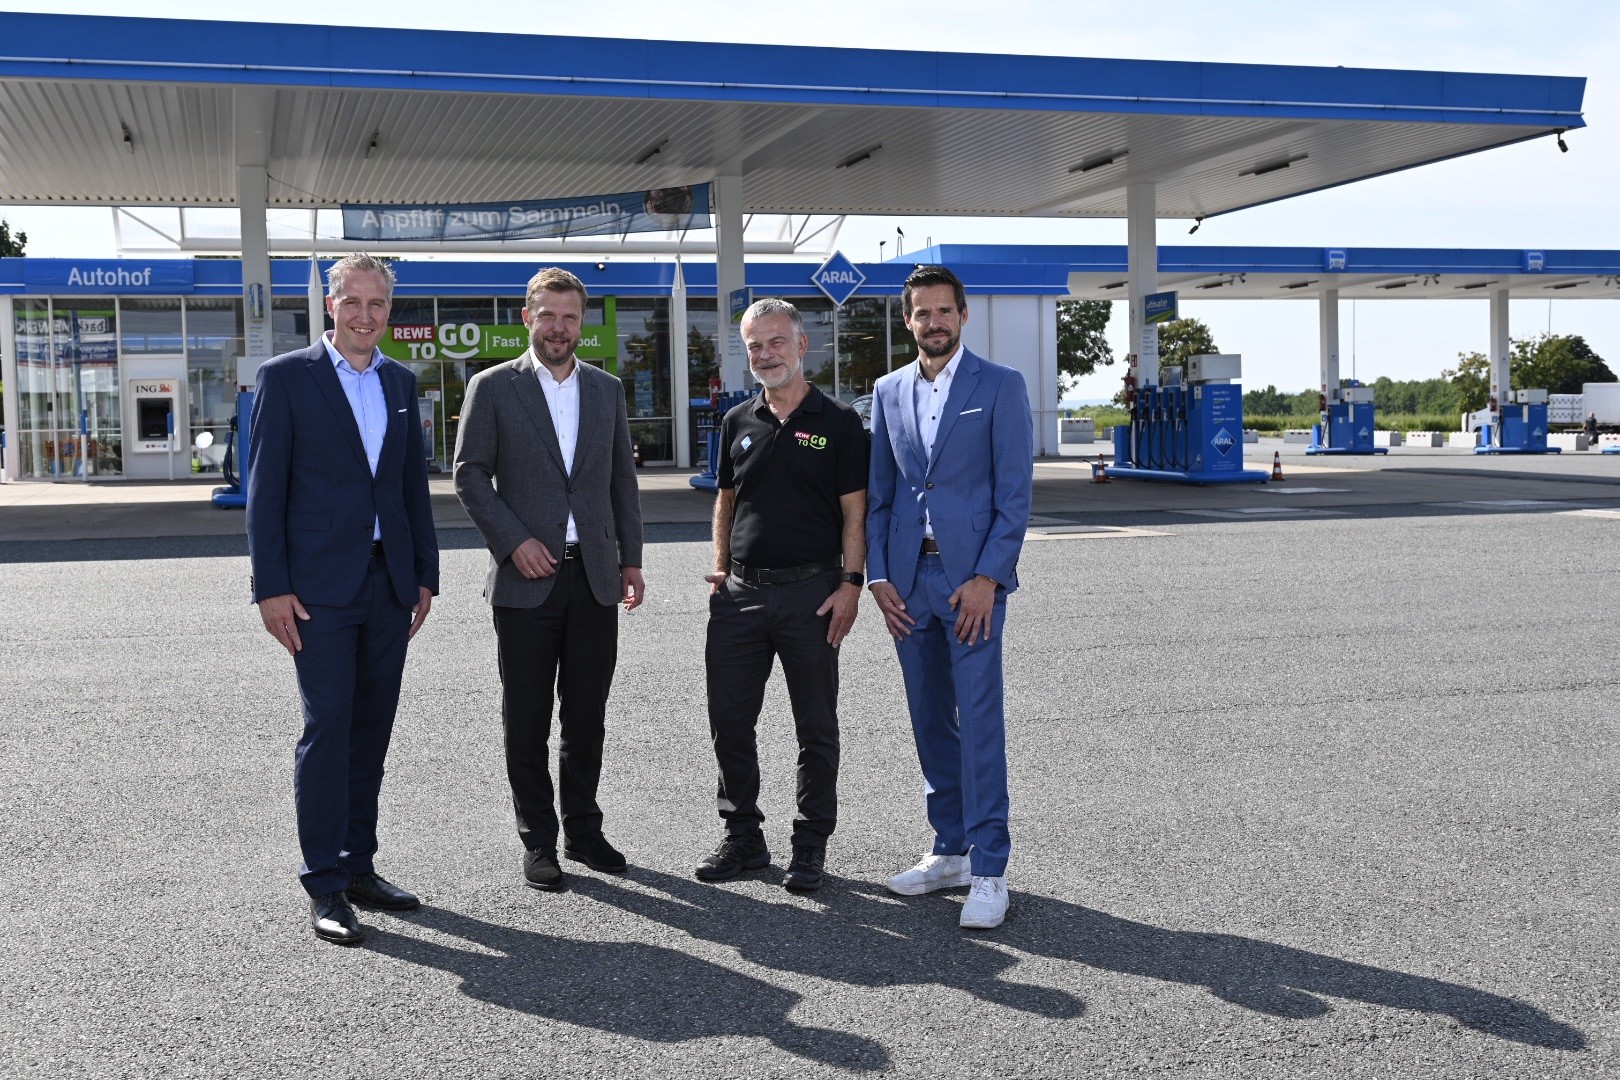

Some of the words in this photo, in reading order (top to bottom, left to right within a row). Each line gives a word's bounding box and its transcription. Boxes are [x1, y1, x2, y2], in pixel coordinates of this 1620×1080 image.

[361, 209, 443, 232] Anpfiff
[450, 210, 502, 228] zum
[508, 200, 626, 224] Sammeln.
[67, 266, 152, 286] Autohof
[820, 270, 858, 284] ARAL
[393, 326, 433, 340] REWE
[438, 322, 481, 347] GO
[492, 335, 524, 347] Fast.
[577, 335, 602, 347] ood.
[407, 342, 437, 360] TO
[136, 385, 157, 393] ING
[797, 438, 809, 447] TO
[810, 434, 827, 447] GO
[1214, 437, 1233, 445] ARAL
